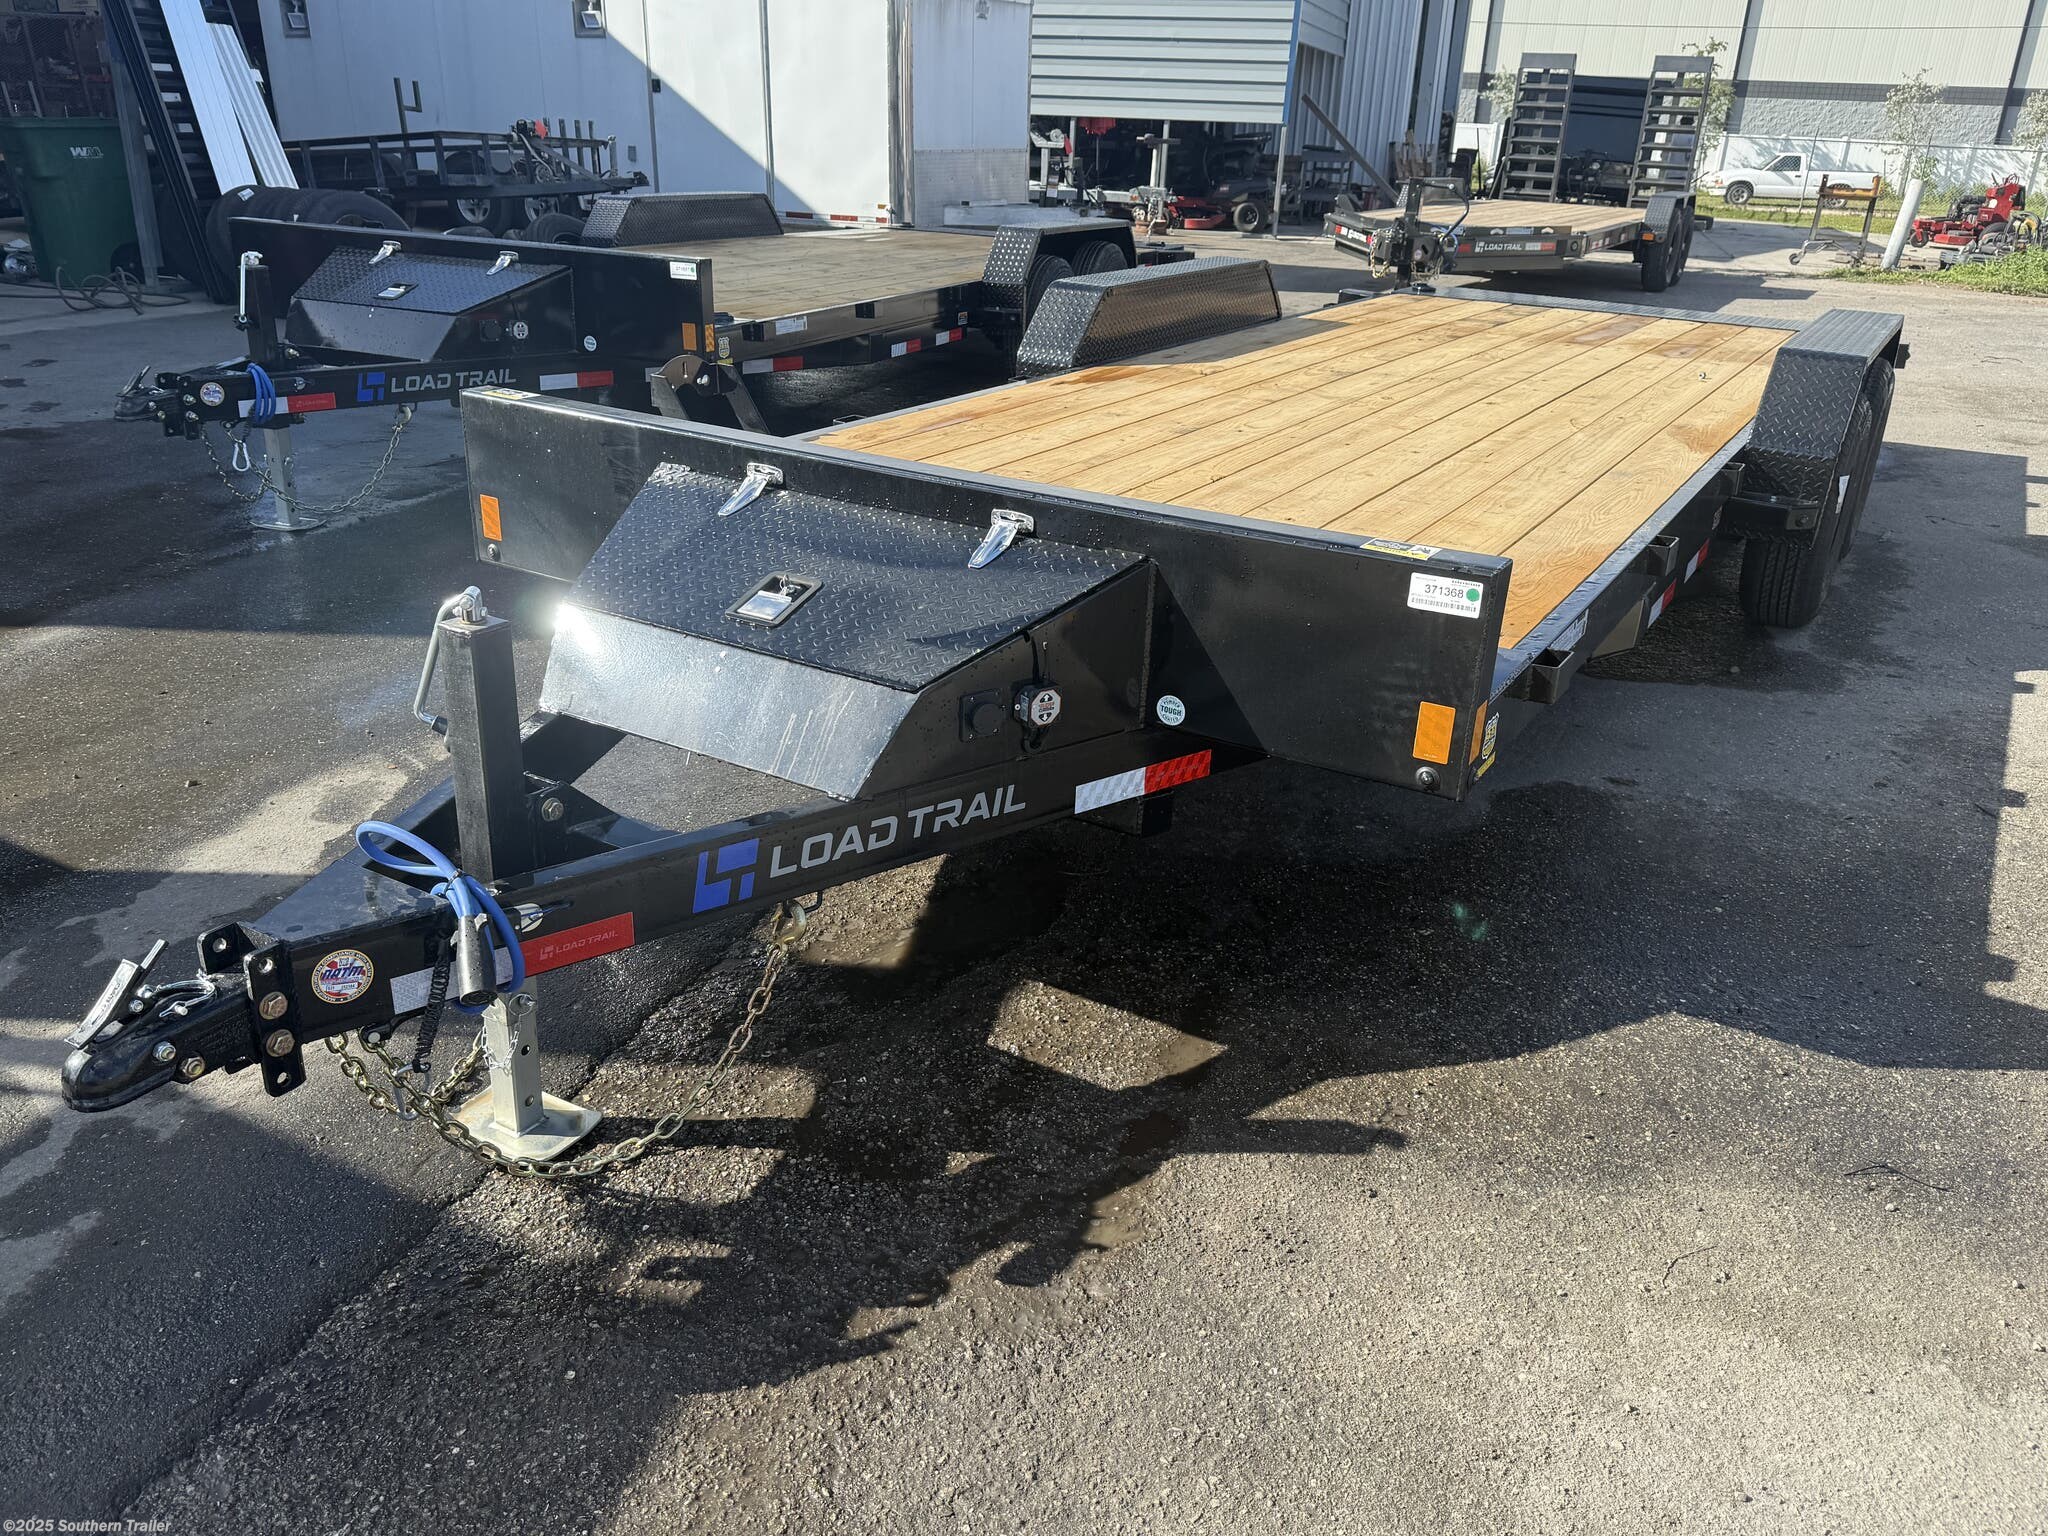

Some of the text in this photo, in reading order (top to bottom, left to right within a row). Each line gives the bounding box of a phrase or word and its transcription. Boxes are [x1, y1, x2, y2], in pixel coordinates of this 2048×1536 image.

[391, 373, 451, 393] LOAD
[455, 368, 517, 387] TRAIL
[1424, 584, 1464, 599] 371368
[1160, 705, 1182, 717] TOUGH
[769, 815, 899, 879] LOAD
[907, 784, 1026, 839] TRAIL
[555, 930, 619, 953] LOAD TRAIL
[321, 965, 365, 981] NATM
